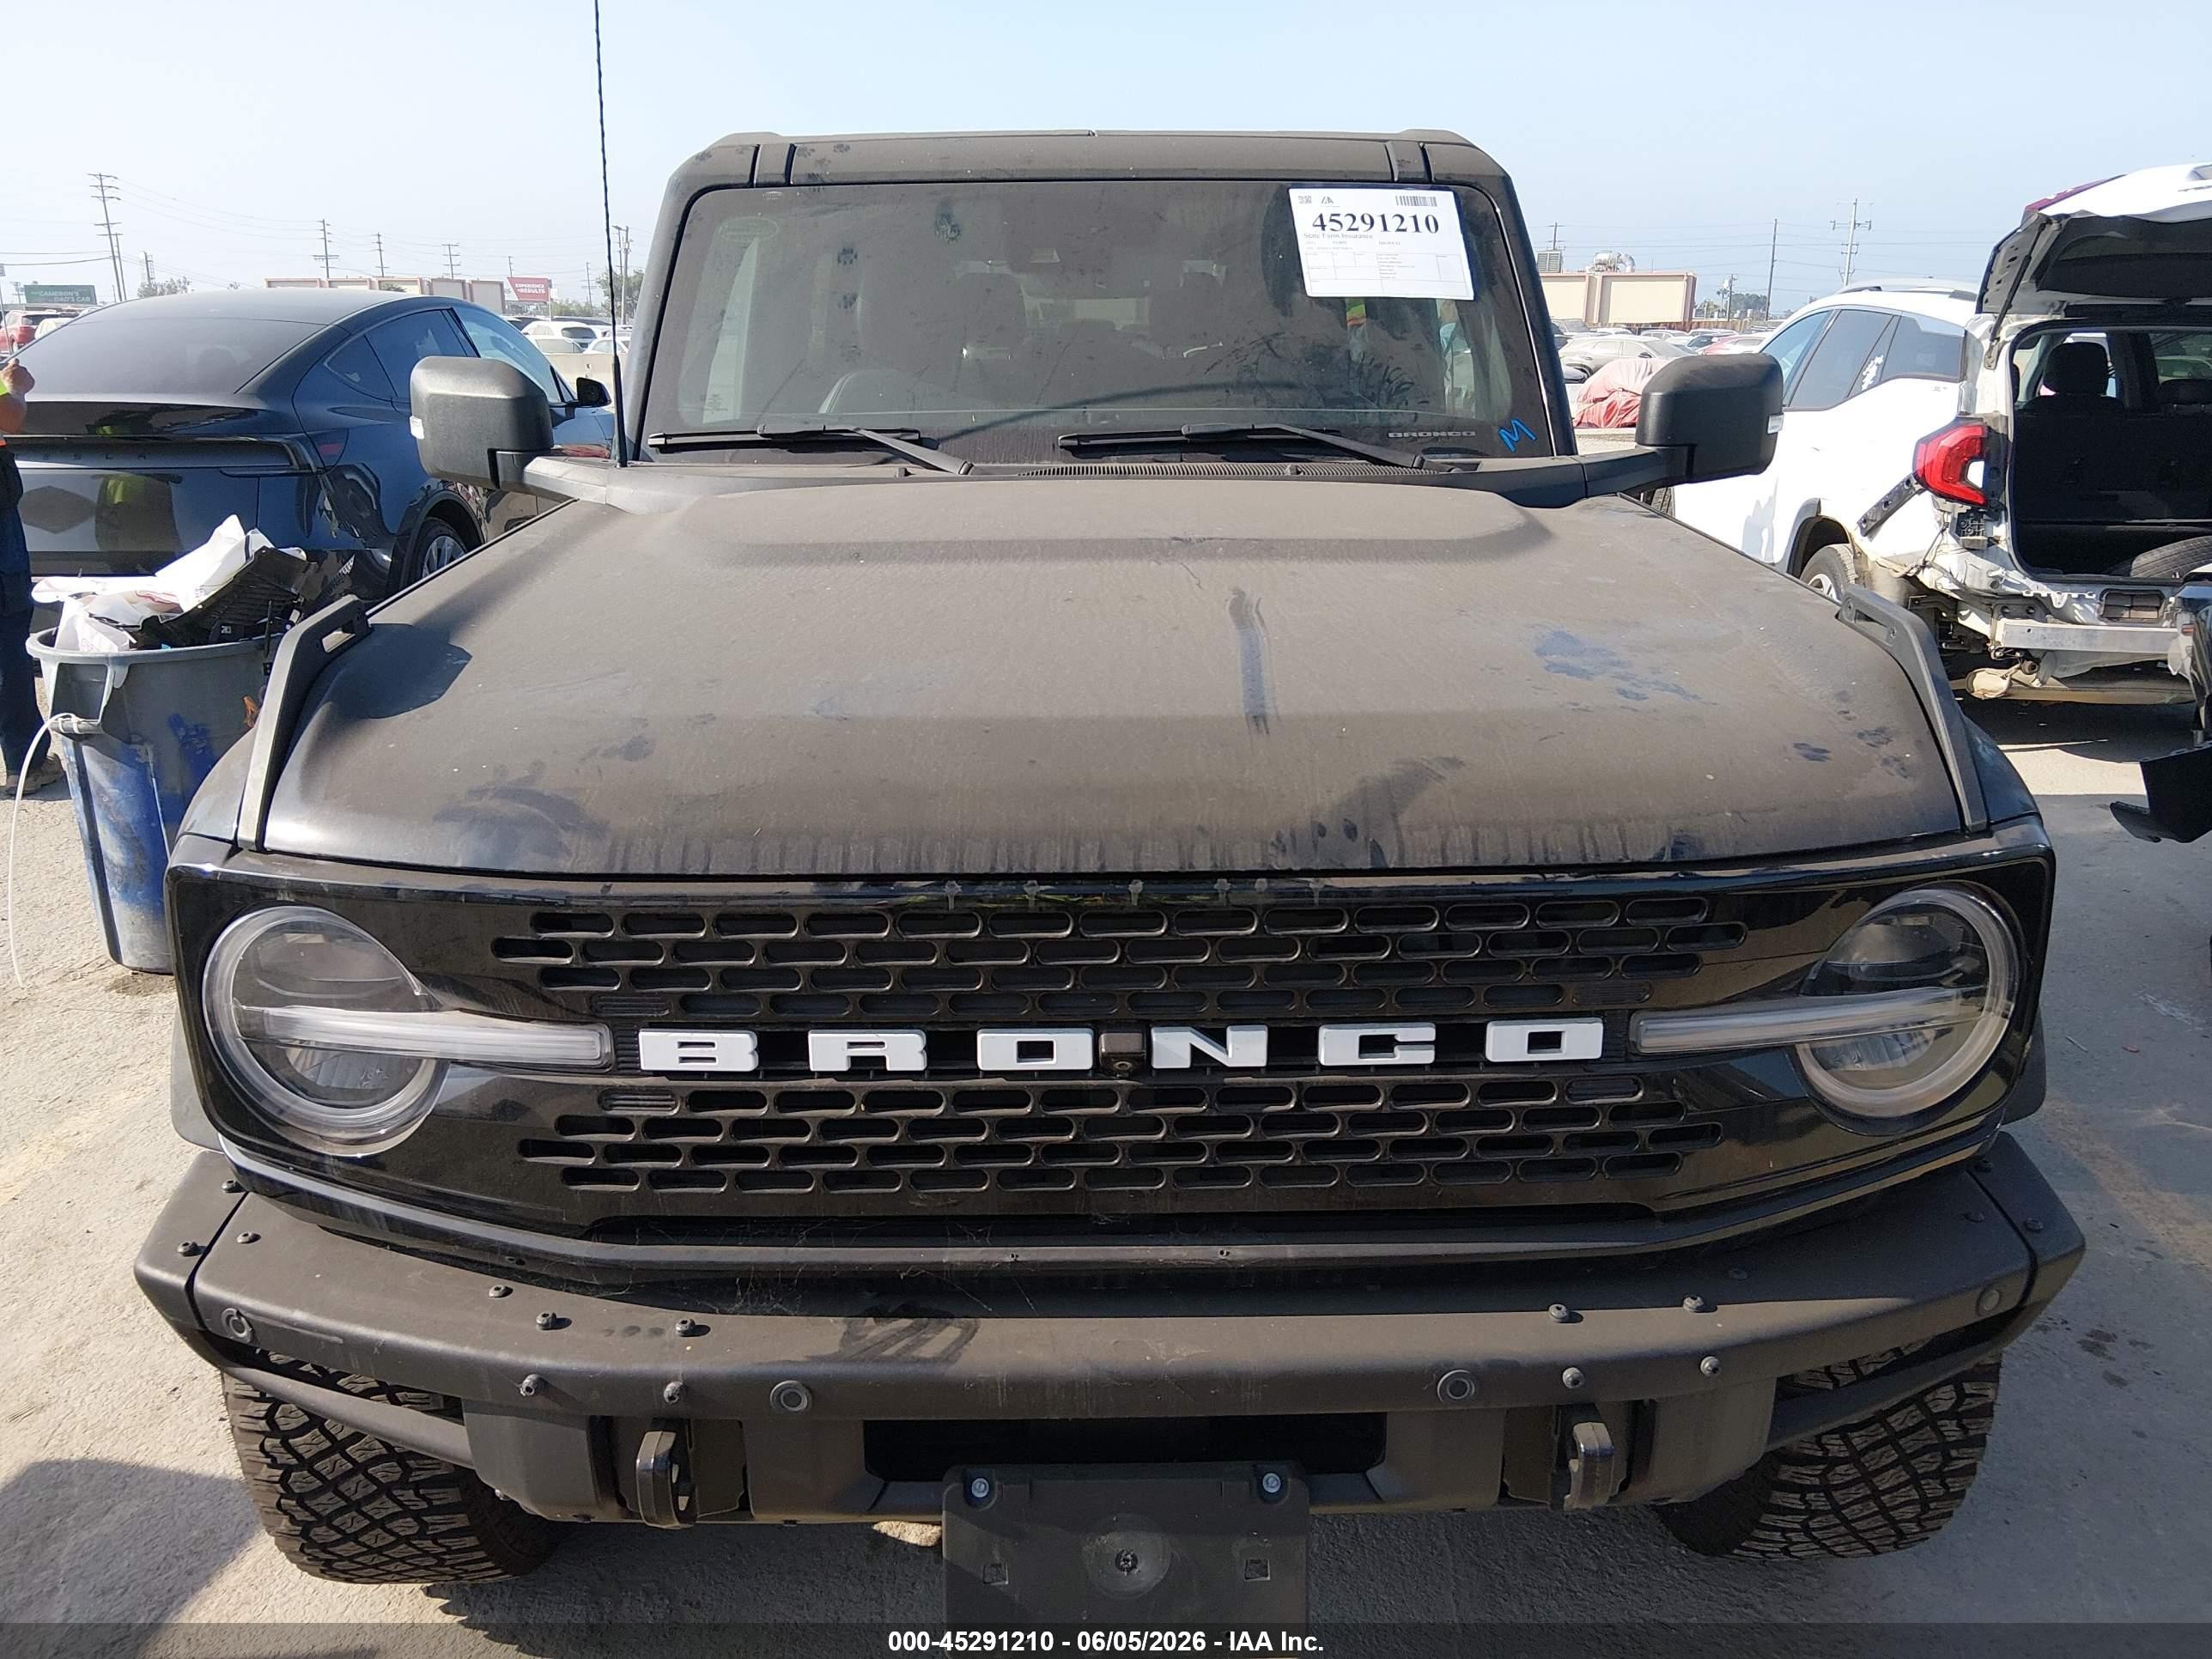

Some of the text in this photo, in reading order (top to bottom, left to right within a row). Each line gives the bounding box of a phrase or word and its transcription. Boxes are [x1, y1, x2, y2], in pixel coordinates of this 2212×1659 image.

[1312, 212, 1439, 234] 45291210
[1498, 418, 1537, 453] M
[639, 1018, 1604, 1073] BRONCO
